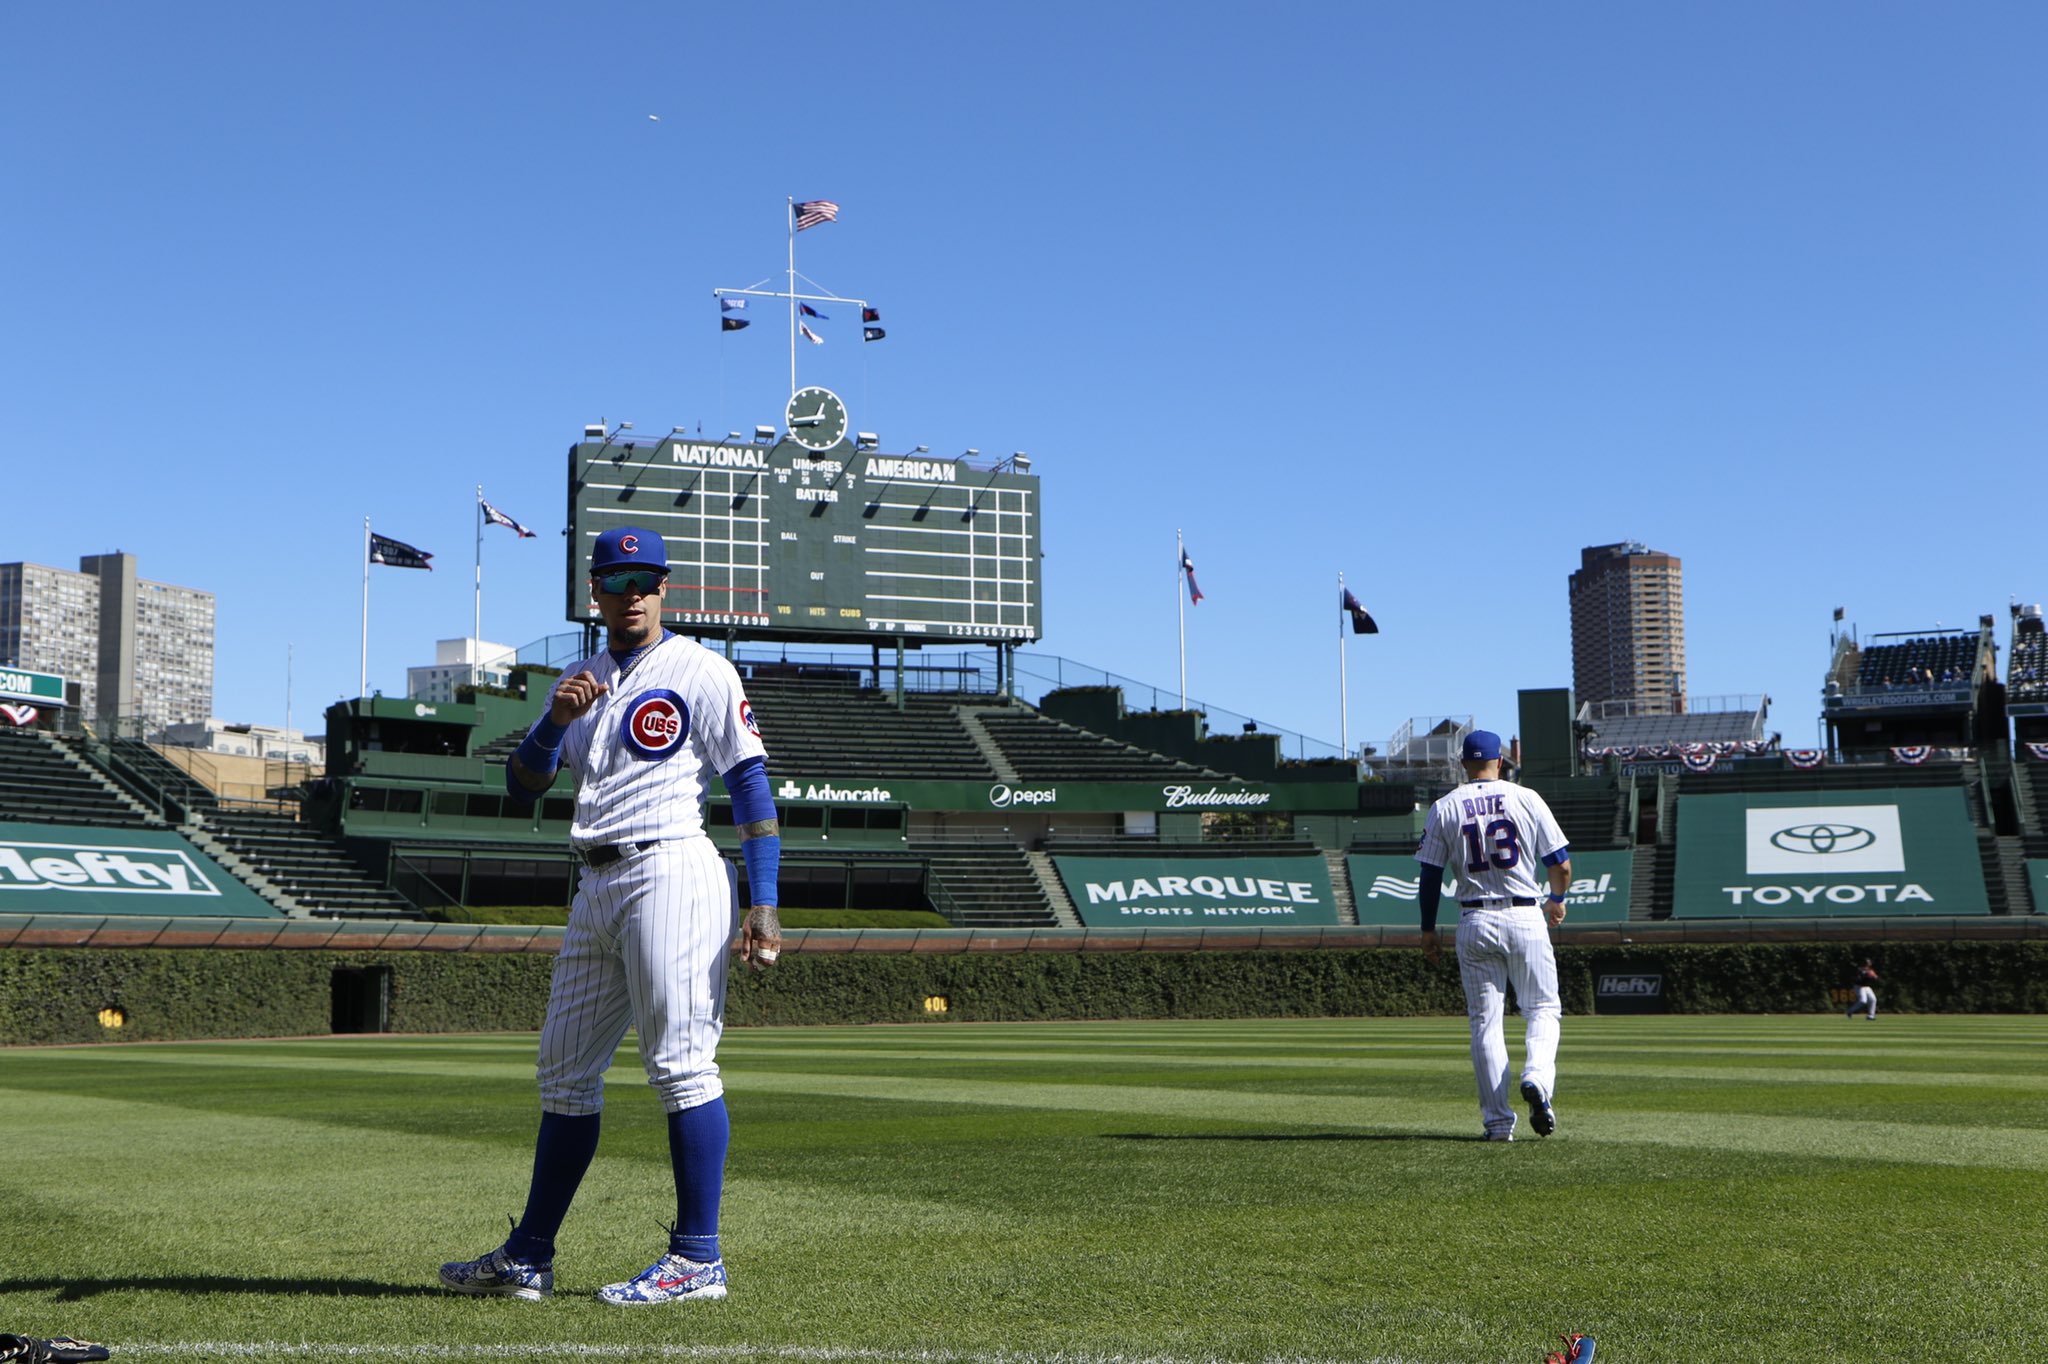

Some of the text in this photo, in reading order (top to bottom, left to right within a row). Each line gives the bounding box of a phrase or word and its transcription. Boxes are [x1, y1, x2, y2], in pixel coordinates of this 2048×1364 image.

[673, 444, 769, 469] NATIONAL
[793, 458, 842, 472] UMPIRES
[865, 458, 956, 481] AMERICAN
[796, 488, 838, 502] BATTER
[781, 532, 797, 540] BALL
[833, 535, 856, 544] STRIKE
[619, 534, 639, 554] C
[810, 572, 824, 580] OUT
[778, 605, 791, 614] VIS
[809, 607, 826, 616] HITS
[840, 608, 861, 618] CUBS
[684, 613, 691, 623] 2
[695, 613, 702, 623] 3
[704, 614, 710, 623] 4
[714, 614, 720, 624] 5
[723, 615, 730, 624] 6
[733, 615, 740, 625] 7
[742, 616, 749, 625] 8
[752, 616, 758, 626] 9
[760, 616, 769, 626] 10
[956, 626, 963, 635] 2
[965, 626, 972, 636] 3
[974, 627, 980, 636] 4
[983, 627, 989, 636] 5
[991, 627, 998, 637] 6
[1000, 628, 1007, 637] 7
[1009, 629, 1016, 638] 8
[1018, 629, 1024, 638] 9
[1026, 629, 1034, 638] 10
[805, 783, 891, 801] Advocate
[1013, 788, 1056, 805] pepsi
[1163, 785, 1270, 808] Budweiser
[1463, 794, 1505, 818] BOTE
[1462, 819, 1520, 873] 13
[1085, 876, 1319, 904] MARQUEE
[1722, 884, 1934, 904] TOYOTA
[1120, 905, 1295, 916] SPORTS NETWORK
[1602, 978, 1657, 994] Hefty
